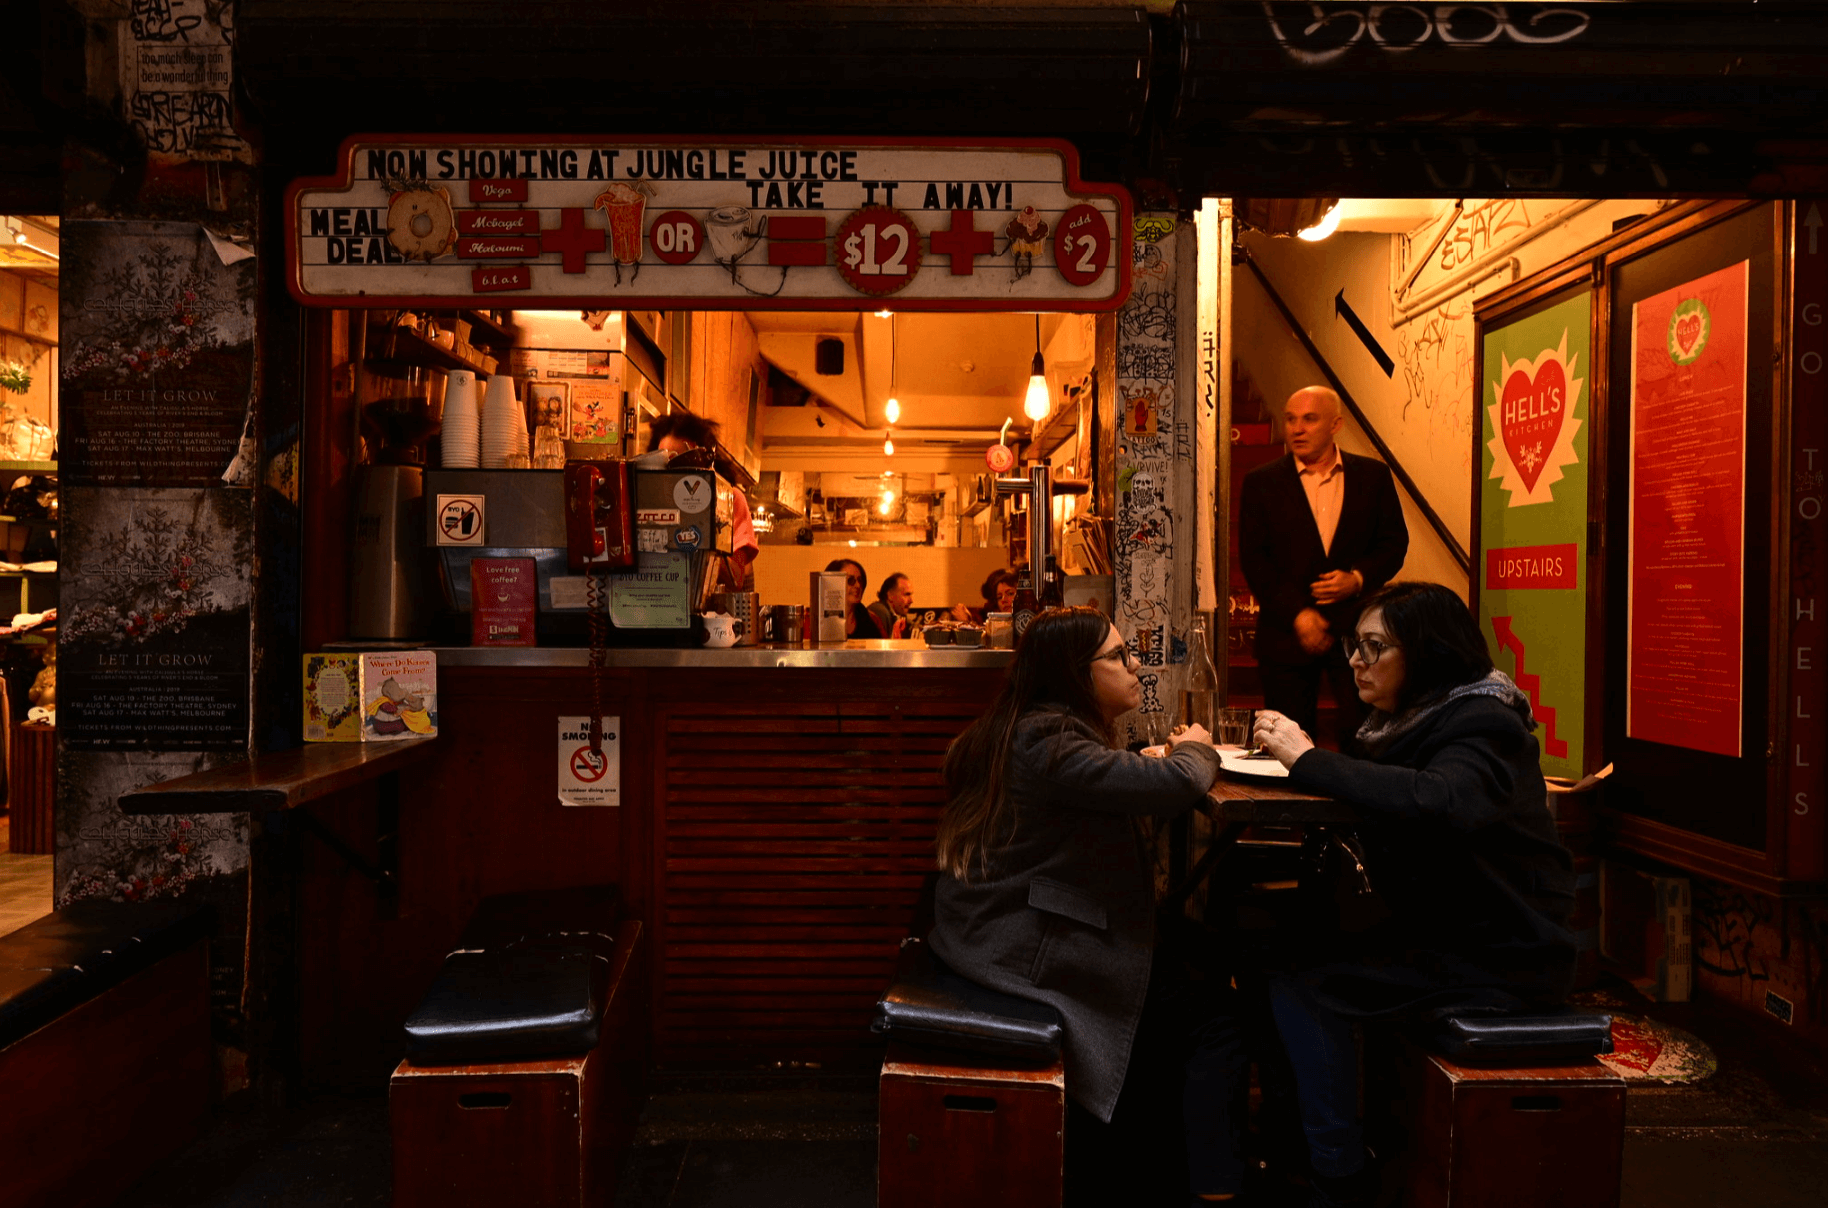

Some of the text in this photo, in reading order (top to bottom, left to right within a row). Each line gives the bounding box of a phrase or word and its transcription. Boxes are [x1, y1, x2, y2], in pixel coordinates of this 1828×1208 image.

[142, 52, 223, 65] too much sleep can
[142, 70, 228, 84] be a wonderful thing
[368, 150, 858, 181] NOW SHOWING AT JUNGLE JUICE
[746, 181, 1013, 210] TAKE IT AWAY!
[310, 209, 387, 236] MEAL
[1069, 213, 1092, 229] add
[656, 222, 695, 253] OR
[327, 238, 402, 264] DEAL
[843, 223, 909, 275] $12
[1063, 232, 1097, 273] $2
[103, 390, 217, 401] LET IT GROW
[1505, 385, 1561, 426] HELL'S
[1509, 419, 1553, 437] KITCHEN
[636, 572, 663, 582] COFFEE
[665, 572, 679, 582] CUP
[1498, 556, 1563, 578] UPSTAIRS
[98, 653, 212, 666] LET IT GROW
[562, 732, 617, 740] SMONG
